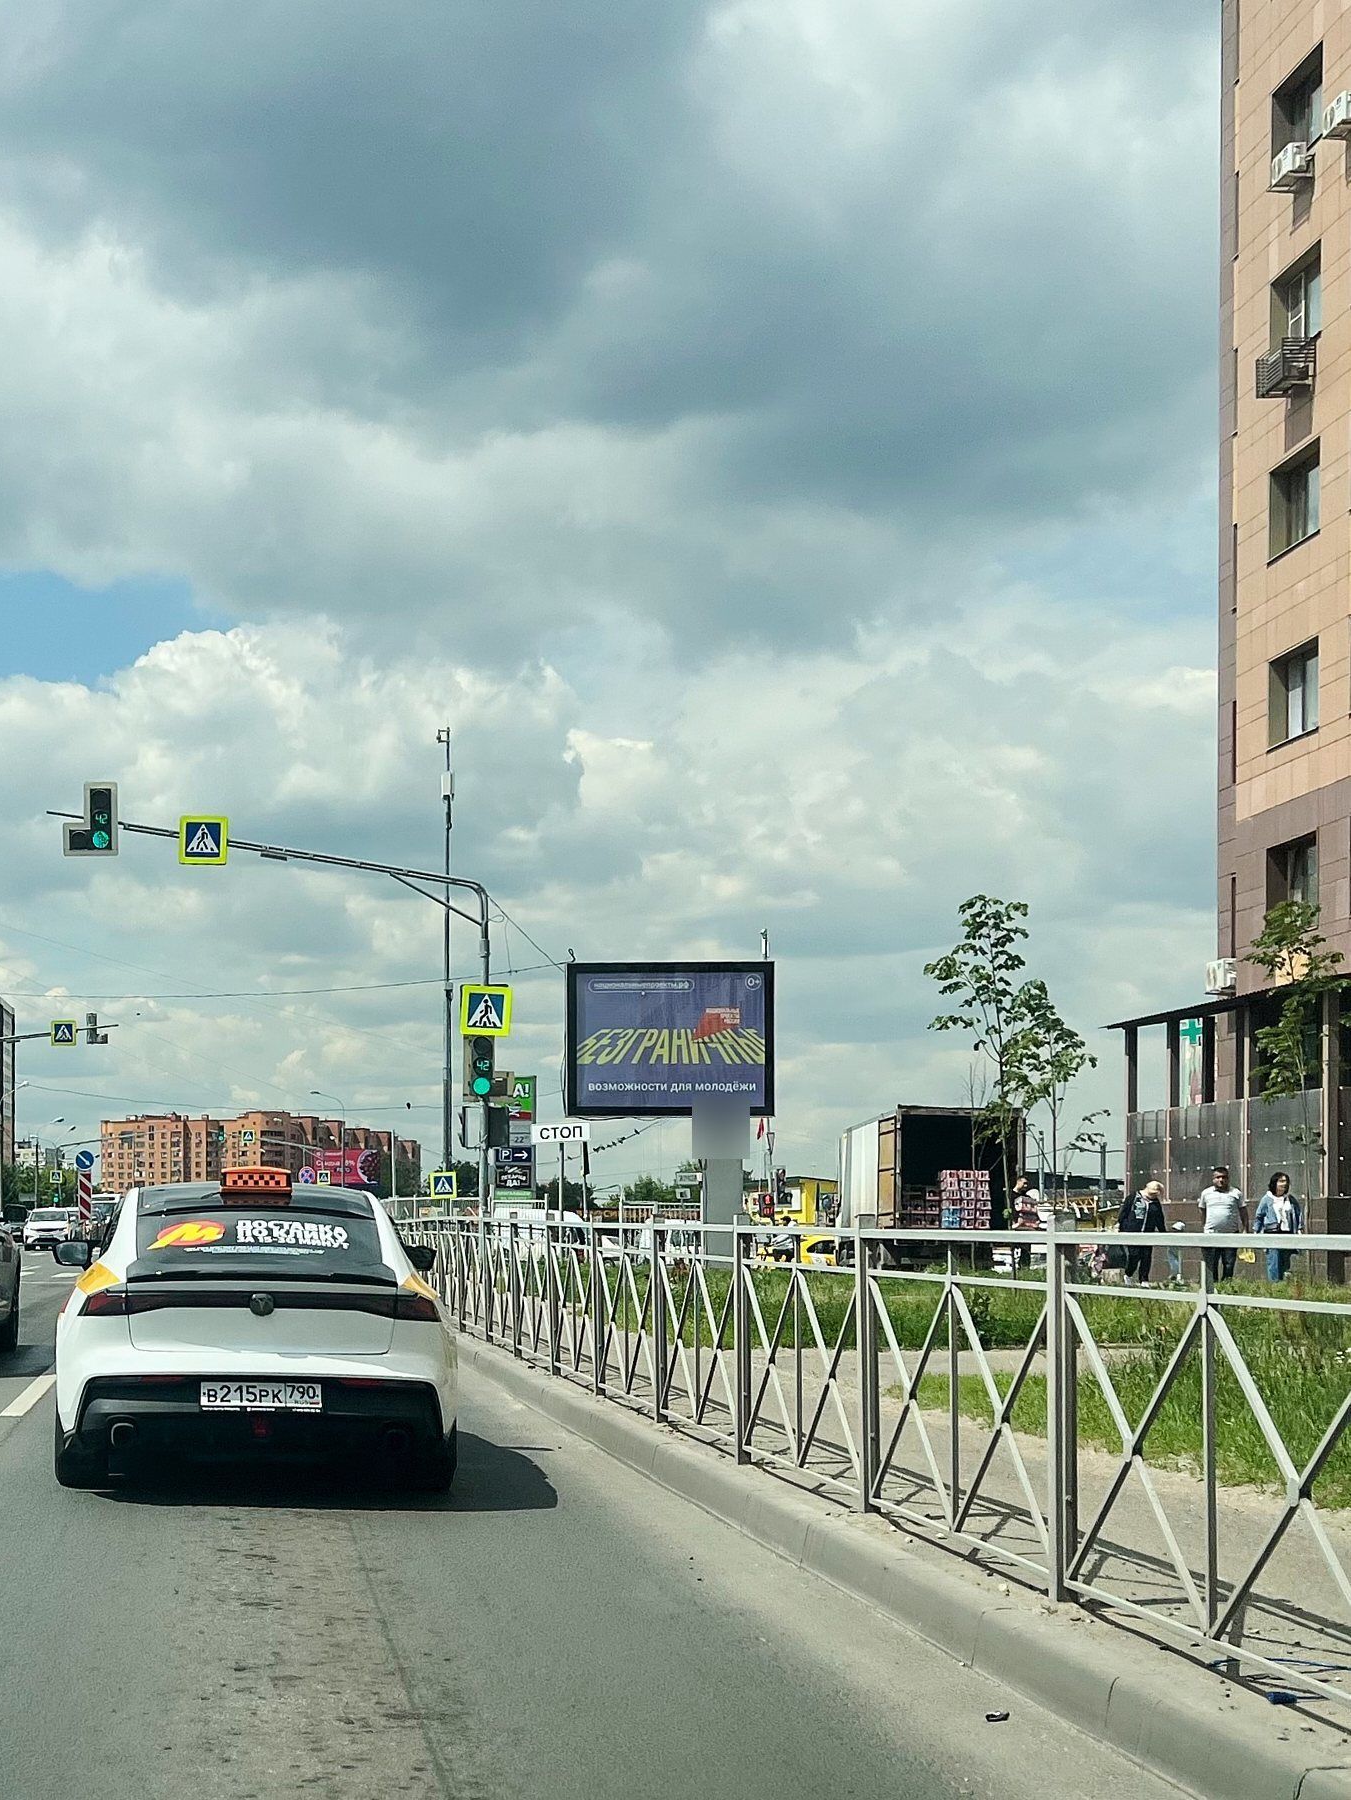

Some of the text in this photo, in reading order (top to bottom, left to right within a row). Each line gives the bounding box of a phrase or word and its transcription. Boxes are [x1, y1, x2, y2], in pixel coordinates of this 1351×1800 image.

[95, 813, 108, 824] 42
[476, 1060, 490, 1071] 42
[588, 1080, 756, 1094] возможности для молодёжи
[539, 1126, 583, 1140] СТОП
[207, 1384, 317, 1404] В215РК 790
